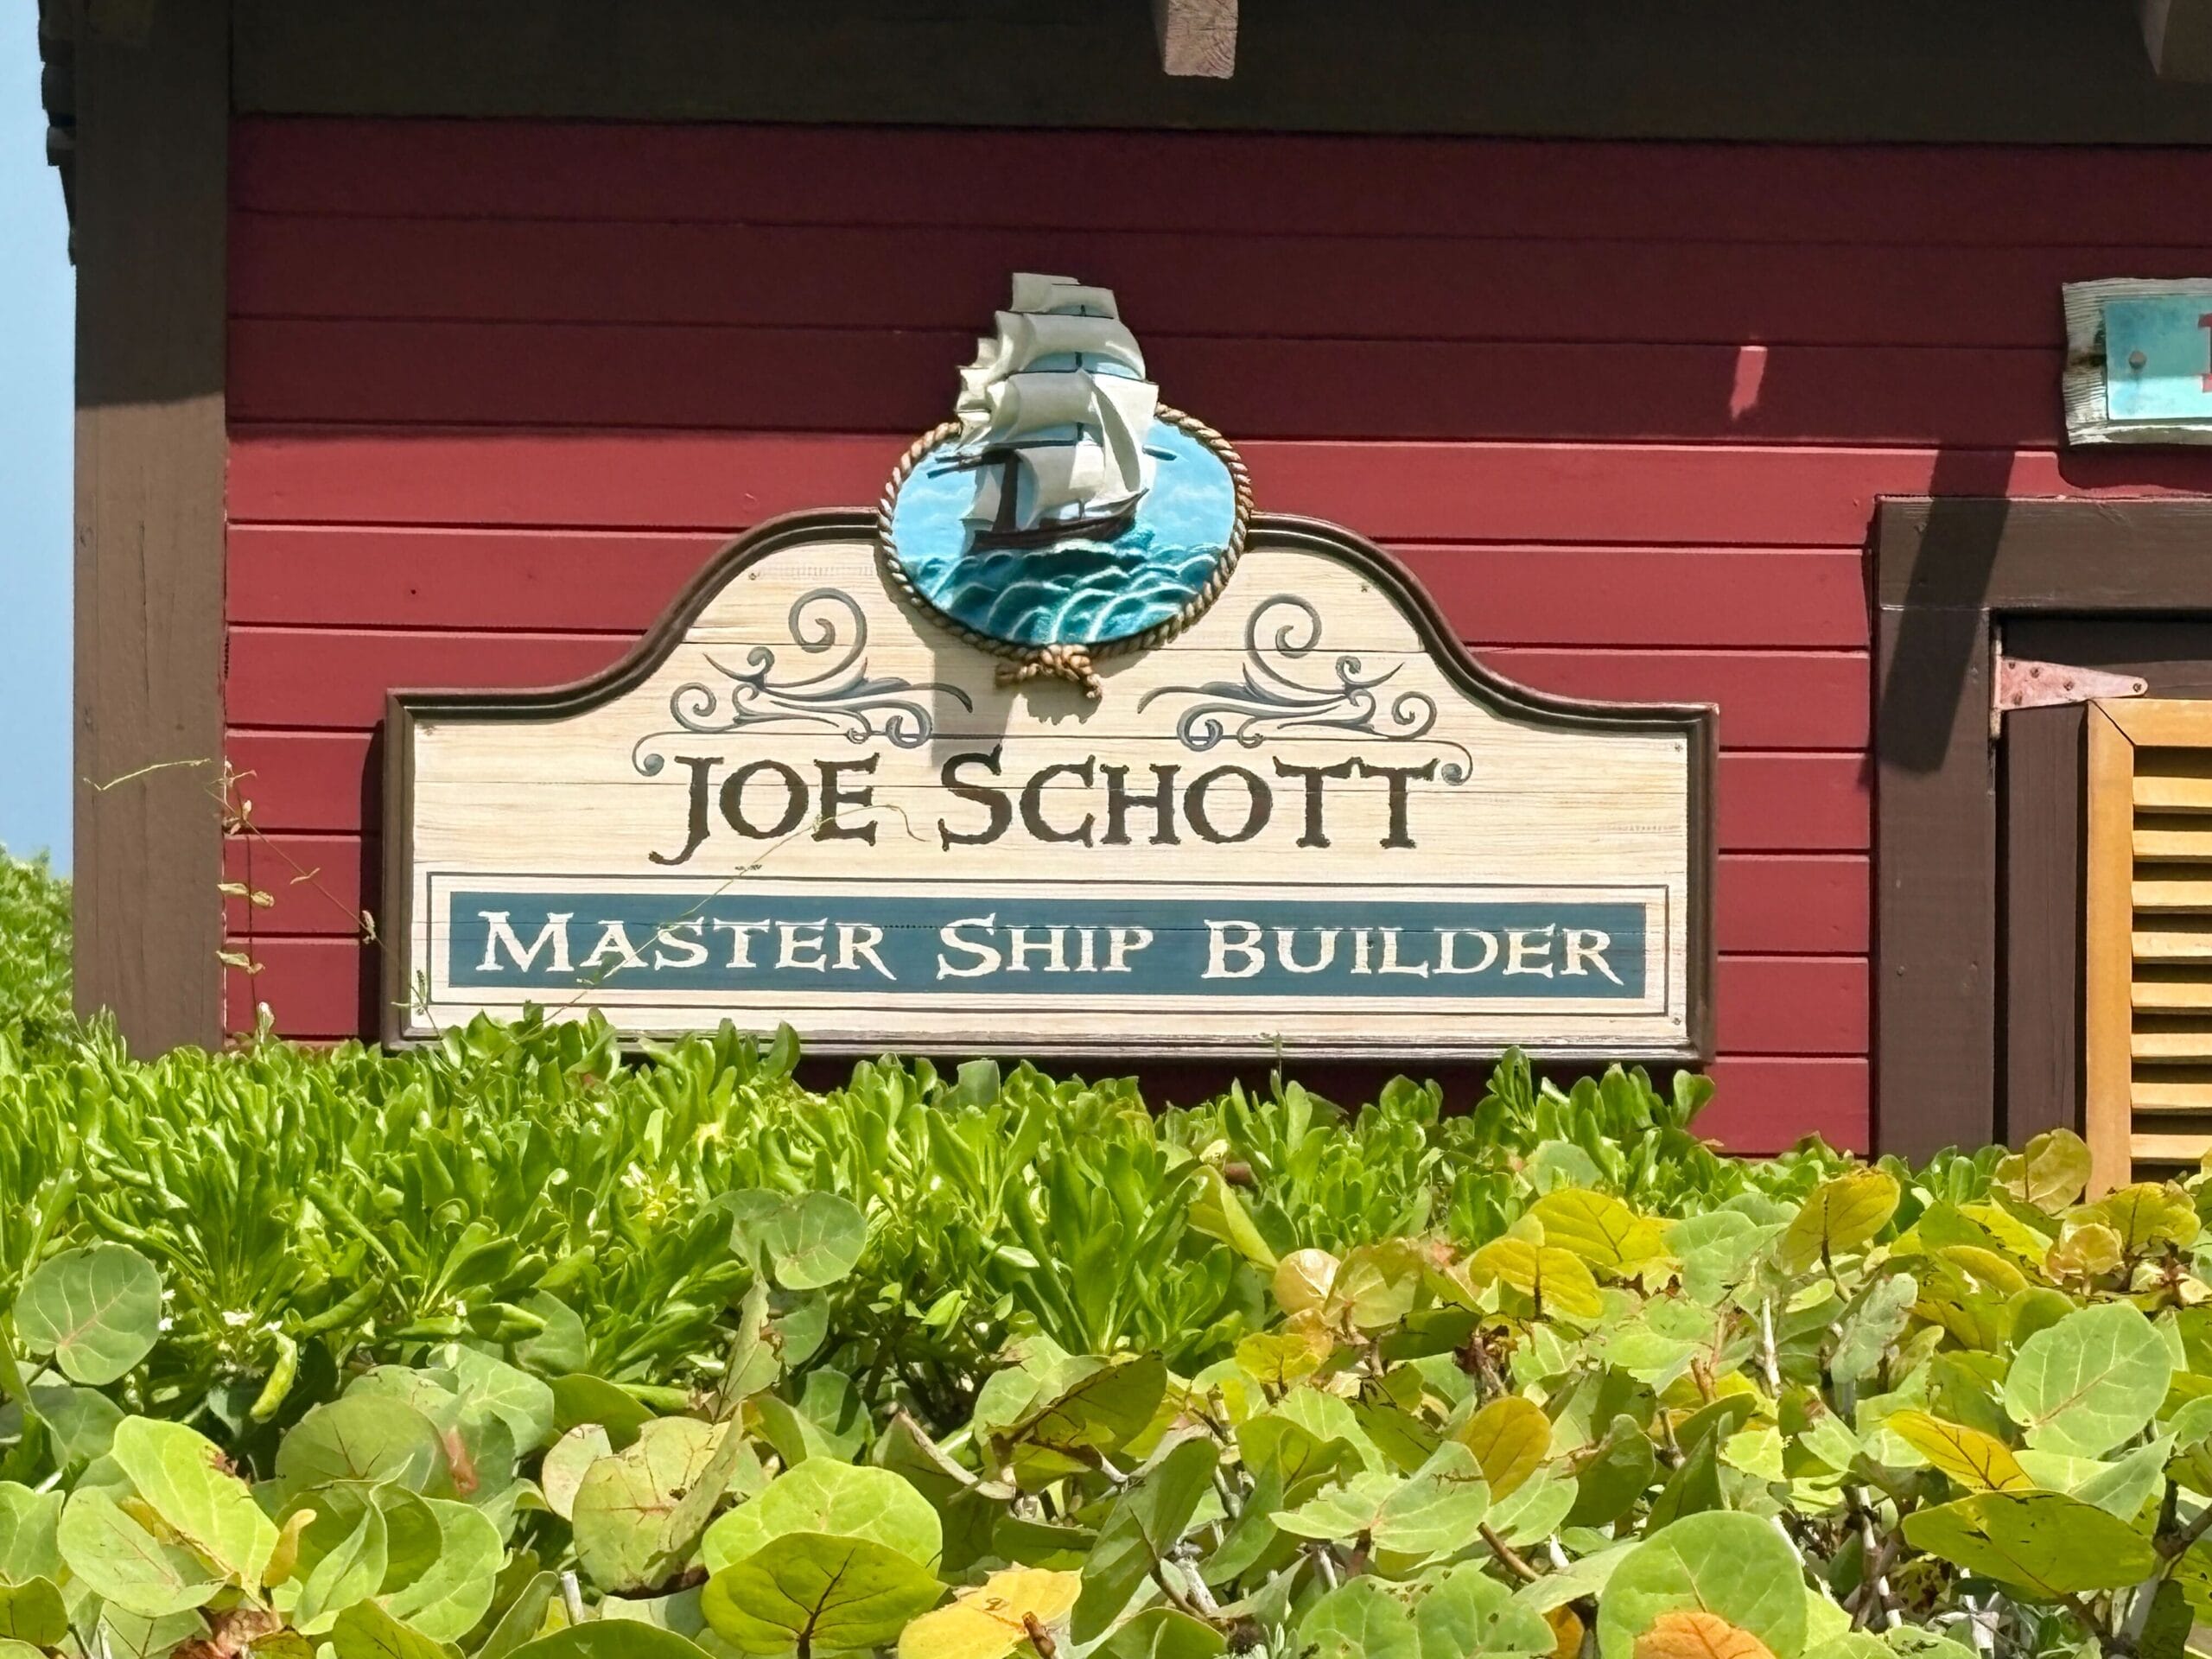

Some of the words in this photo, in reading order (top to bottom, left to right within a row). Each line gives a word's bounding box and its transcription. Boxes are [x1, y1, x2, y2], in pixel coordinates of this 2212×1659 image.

[648, 753, 880, 865] JOE
[938, 744, 1440, 852] SCHOTT
[476, 910, 898, 982] MASTER
[936, 912, 1154, 981] SHIP
[1201, 918, 1625, 986] BUILDER
